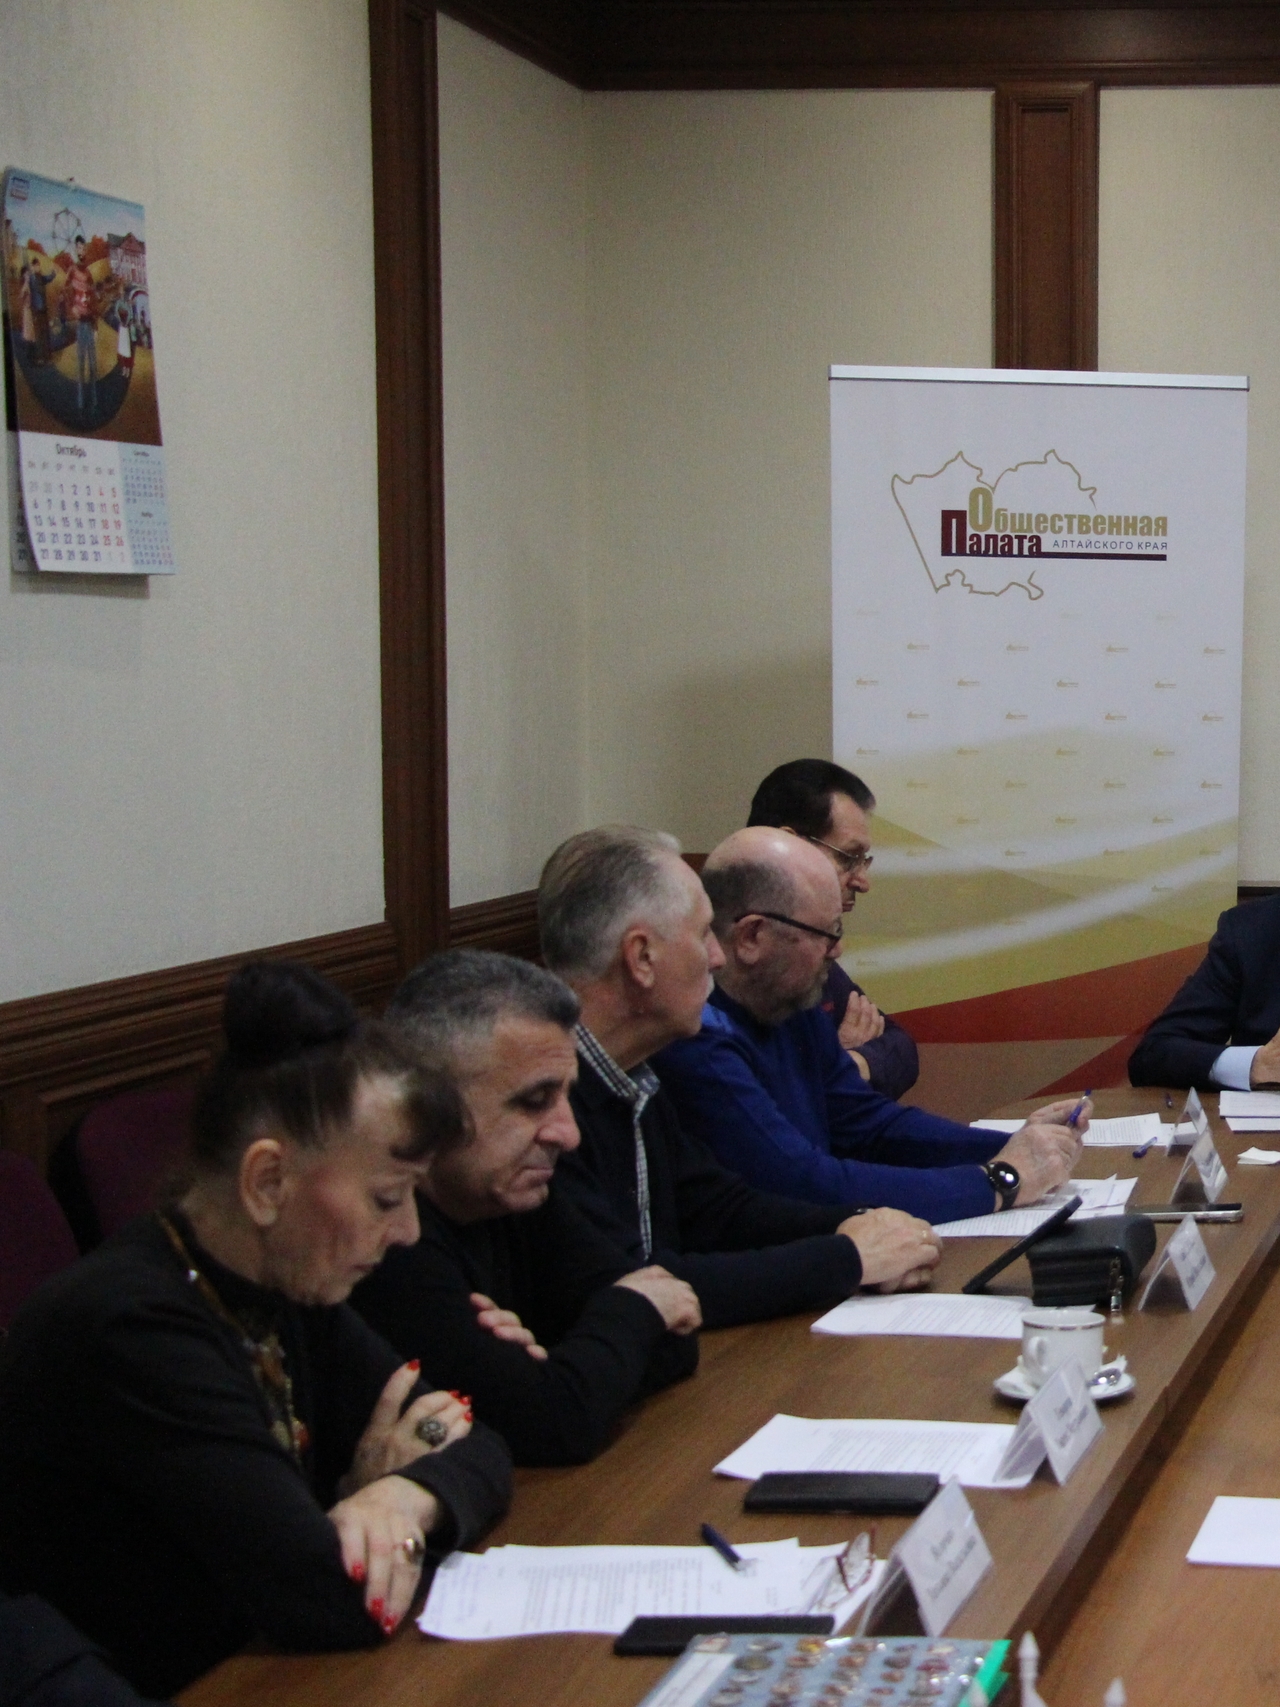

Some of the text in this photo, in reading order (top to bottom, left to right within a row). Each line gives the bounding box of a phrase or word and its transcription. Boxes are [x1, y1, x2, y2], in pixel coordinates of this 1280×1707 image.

[941, 509, 1042, 557] Палата
[968, 486, 1168, 537] Общественная
[1052, 539, 1168, 551] АЛТАЙСКОГО КРАЯ
